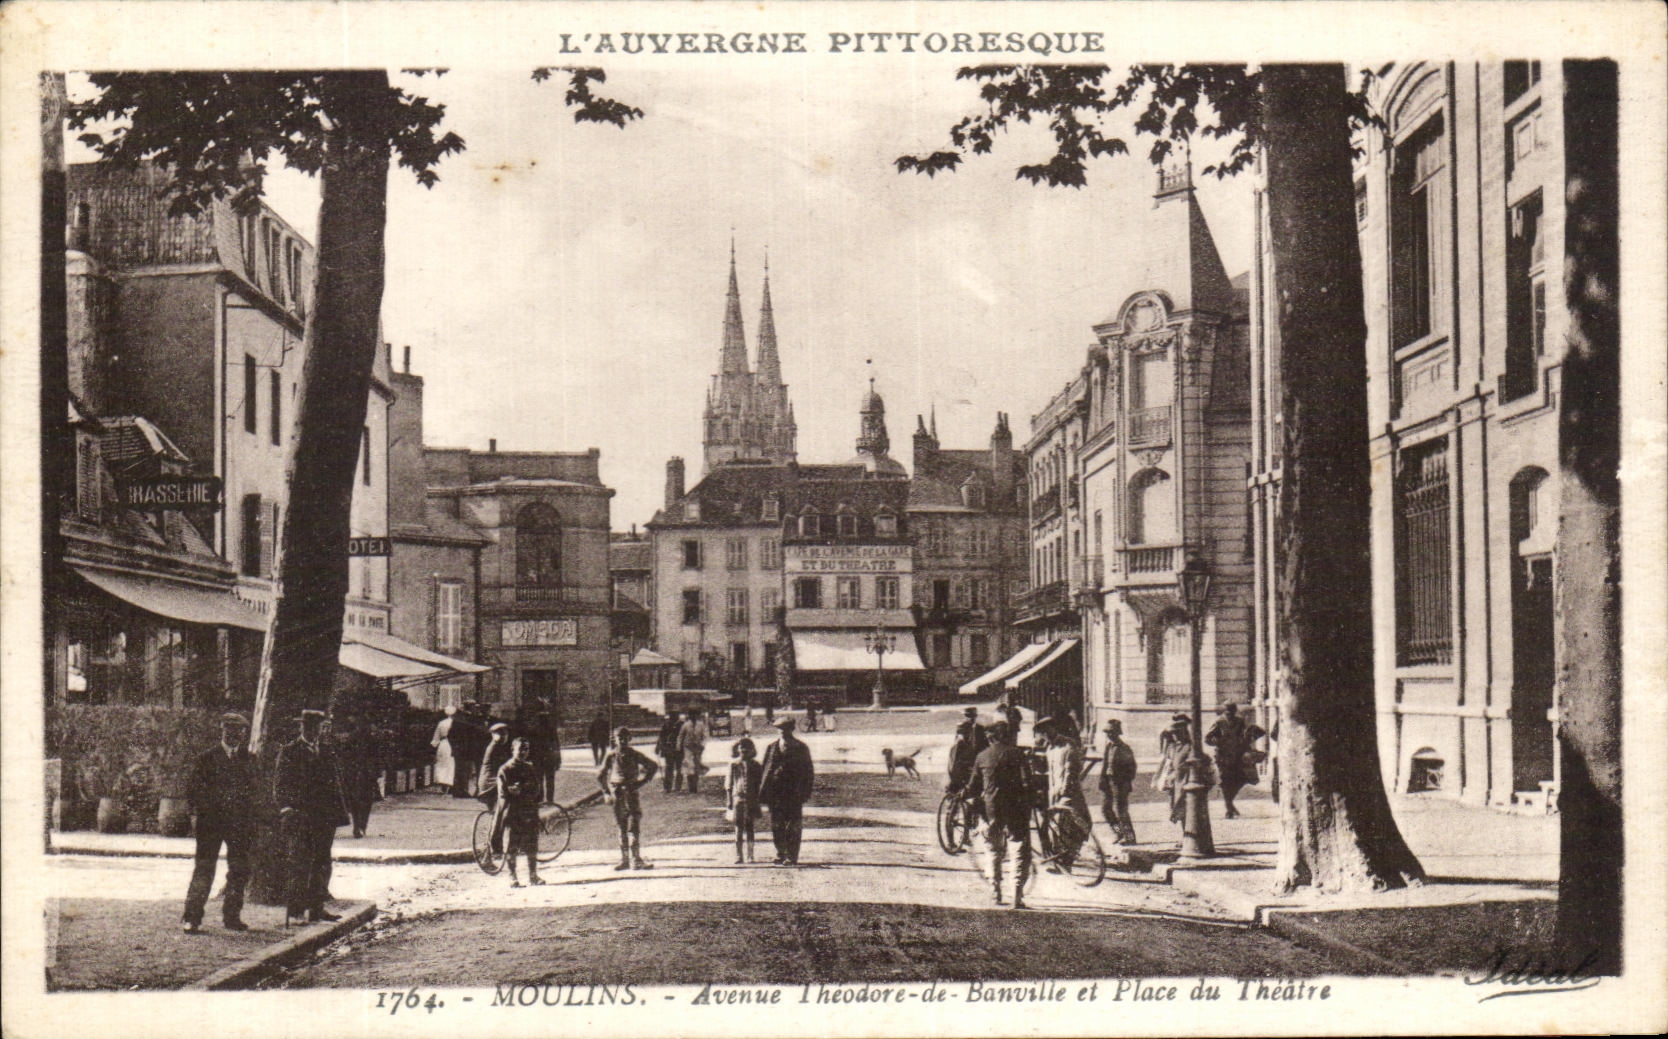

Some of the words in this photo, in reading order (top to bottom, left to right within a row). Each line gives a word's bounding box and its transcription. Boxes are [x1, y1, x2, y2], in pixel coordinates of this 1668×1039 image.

[348, 539, 387, 555] OTEL
[801, 560, 818, 571] ET
[820, 560, 836, 571] DU
